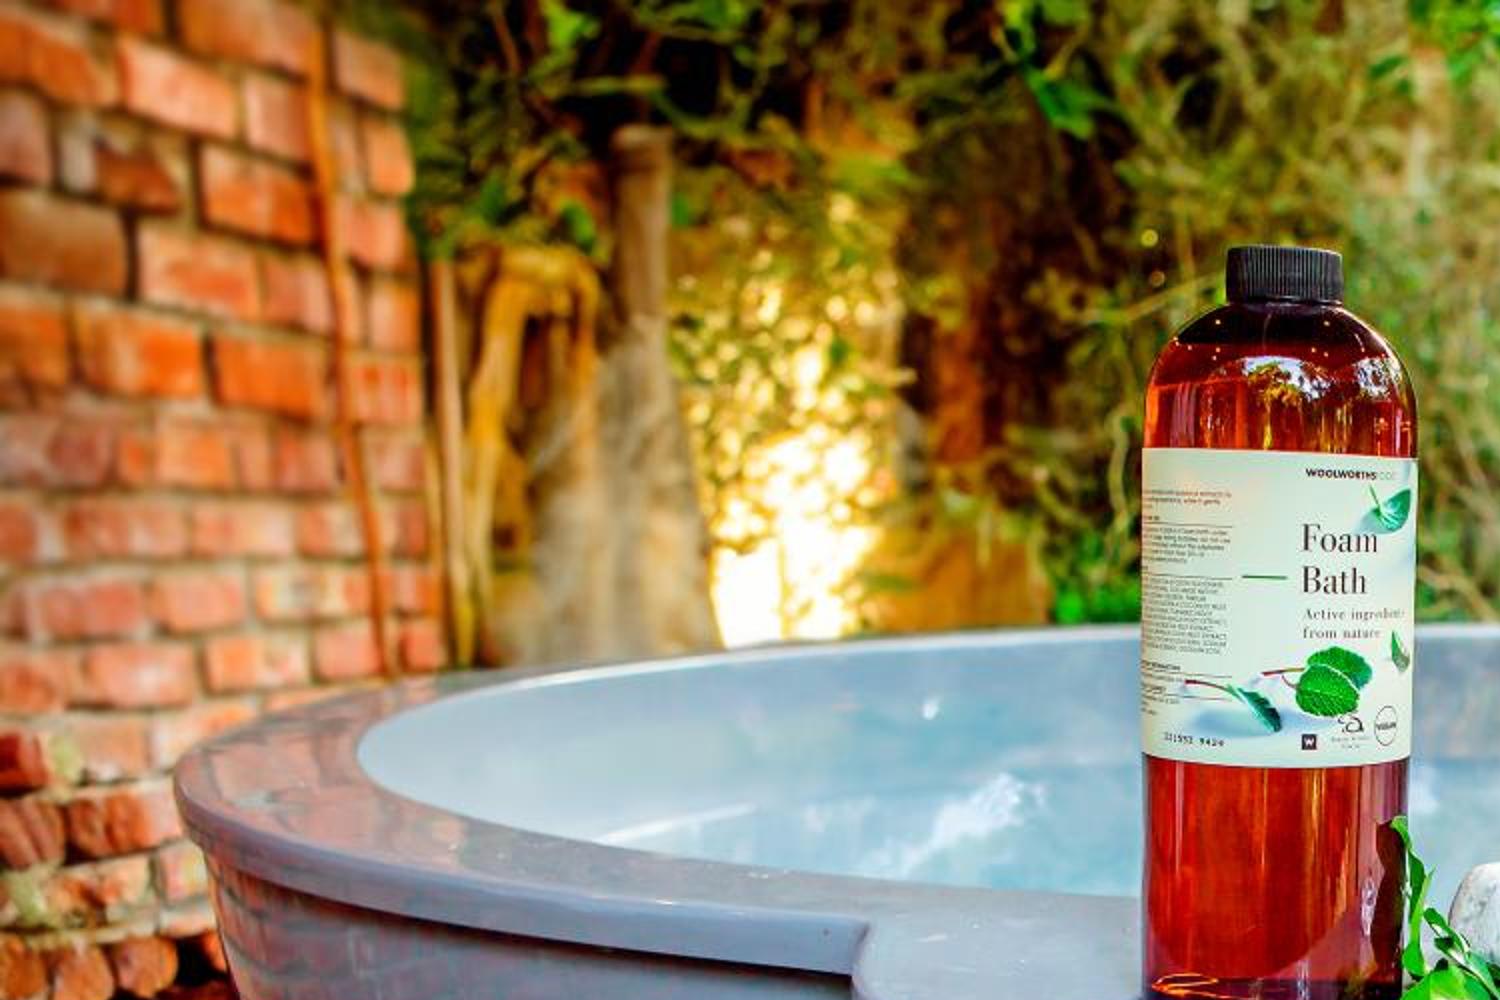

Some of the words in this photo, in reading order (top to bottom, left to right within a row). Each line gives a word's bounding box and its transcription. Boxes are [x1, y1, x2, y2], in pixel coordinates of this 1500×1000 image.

[1305, 468, 1377, 481] WOOLWORTHS
[1302, 523, 1378, 553] Foam
[1302, 565, 1367, 595] Bath
[1303, 608, 1346, 620] Active
[1351, 607, 1405, 621] ingred
[1303, 626, 1338, 639] from
[1343, 628, 1381, 639] nature
